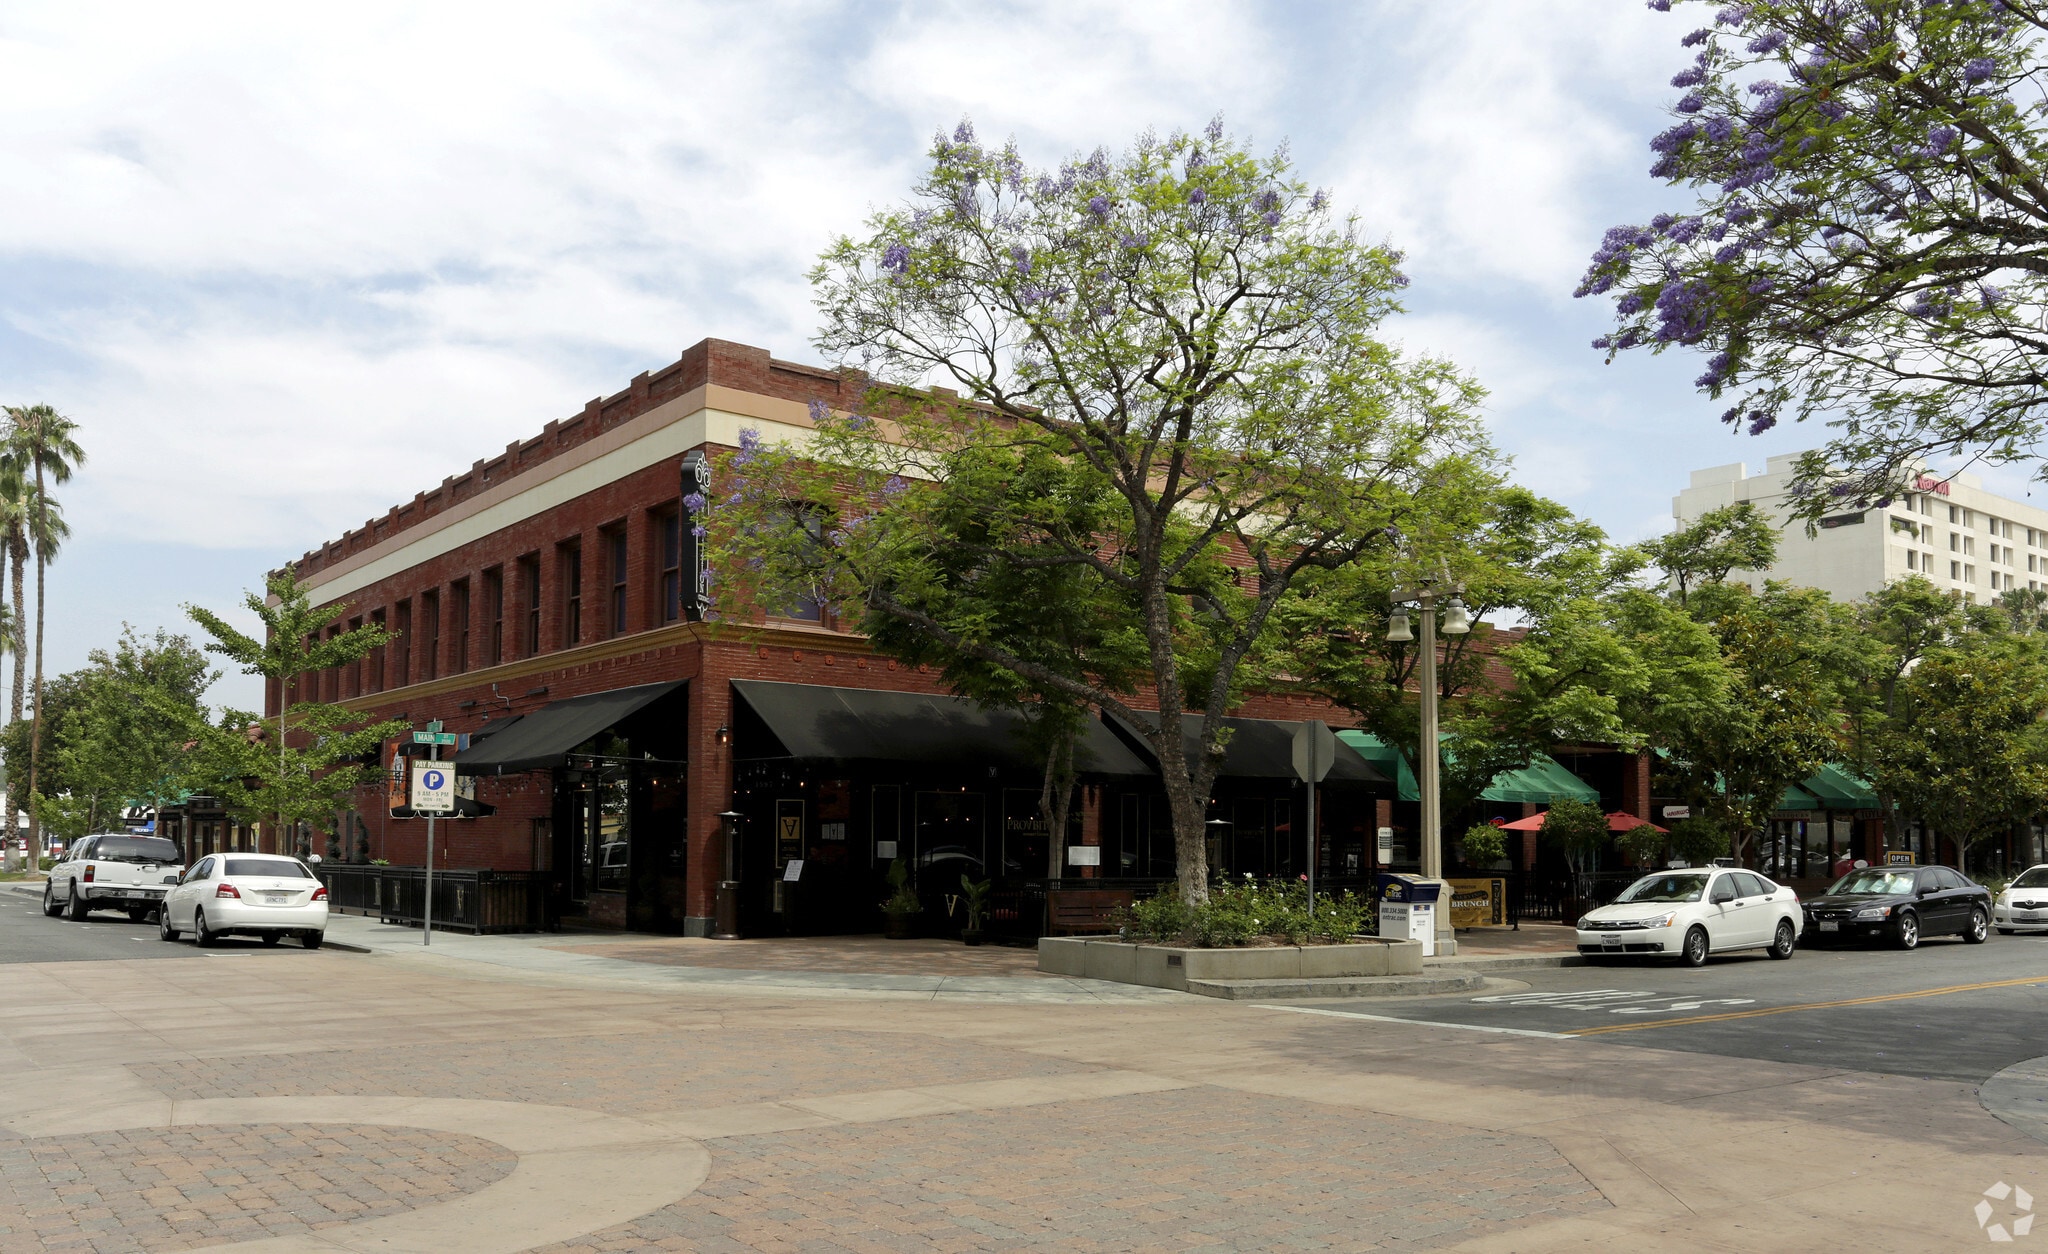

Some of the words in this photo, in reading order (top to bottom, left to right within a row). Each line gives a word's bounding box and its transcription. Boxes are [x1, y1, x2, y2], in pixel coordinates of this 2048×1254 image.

[417, 733, 435, 742] MAIN
[415, 760, 427, 768] PAY
[428, 761, 454, 769] PARKING
[429, 773, 440, 787] P
[1891, 854, 1910, 862] OPEN
[1386, 890, 1402, 898] OnTrac
[1451, 899, 1489, 907] BRUNCH
[1381, 907, 1408, 915] 800.334.5000
